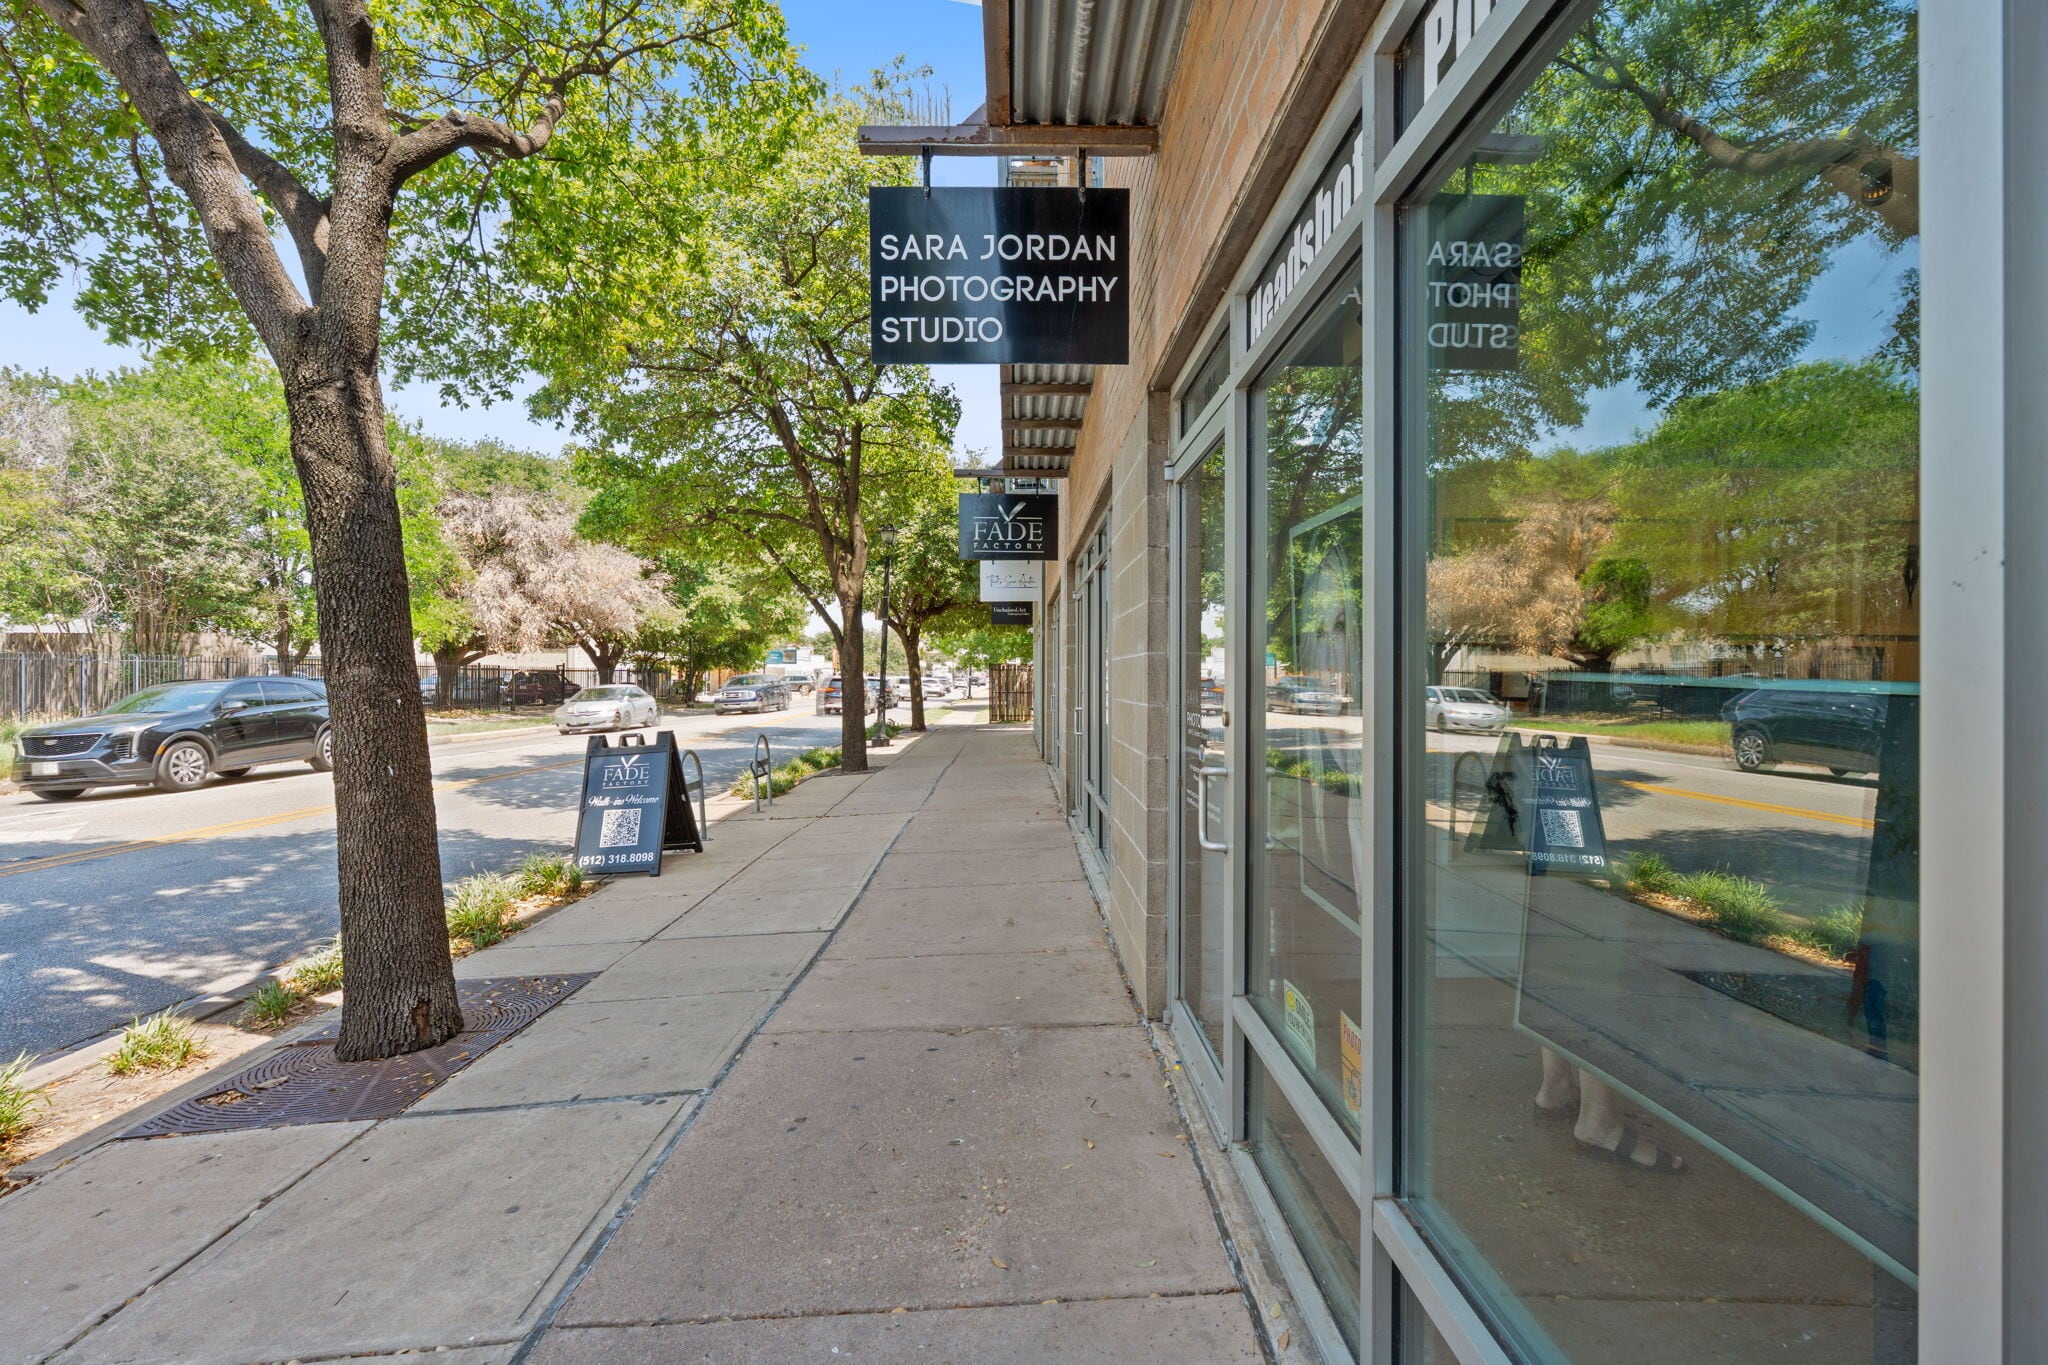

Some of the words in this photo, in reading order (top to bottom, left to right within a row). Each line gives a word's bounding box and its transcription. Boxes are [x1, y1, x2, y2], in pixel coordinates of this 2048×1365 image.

[880, 234, 969, 261] SARA
[980, 234, 1117, 261] JORDAN
[881, 275, 1119, 302] PHOTOGRAPHY
[881, 317, 1003, 343] STUDIO
[973, 521, 1043, 541] FADE
[604, 766, 650, 781] FADE
[579, 855, 605, 868] (512)
[608, 852, 654, 864] 318.8098
